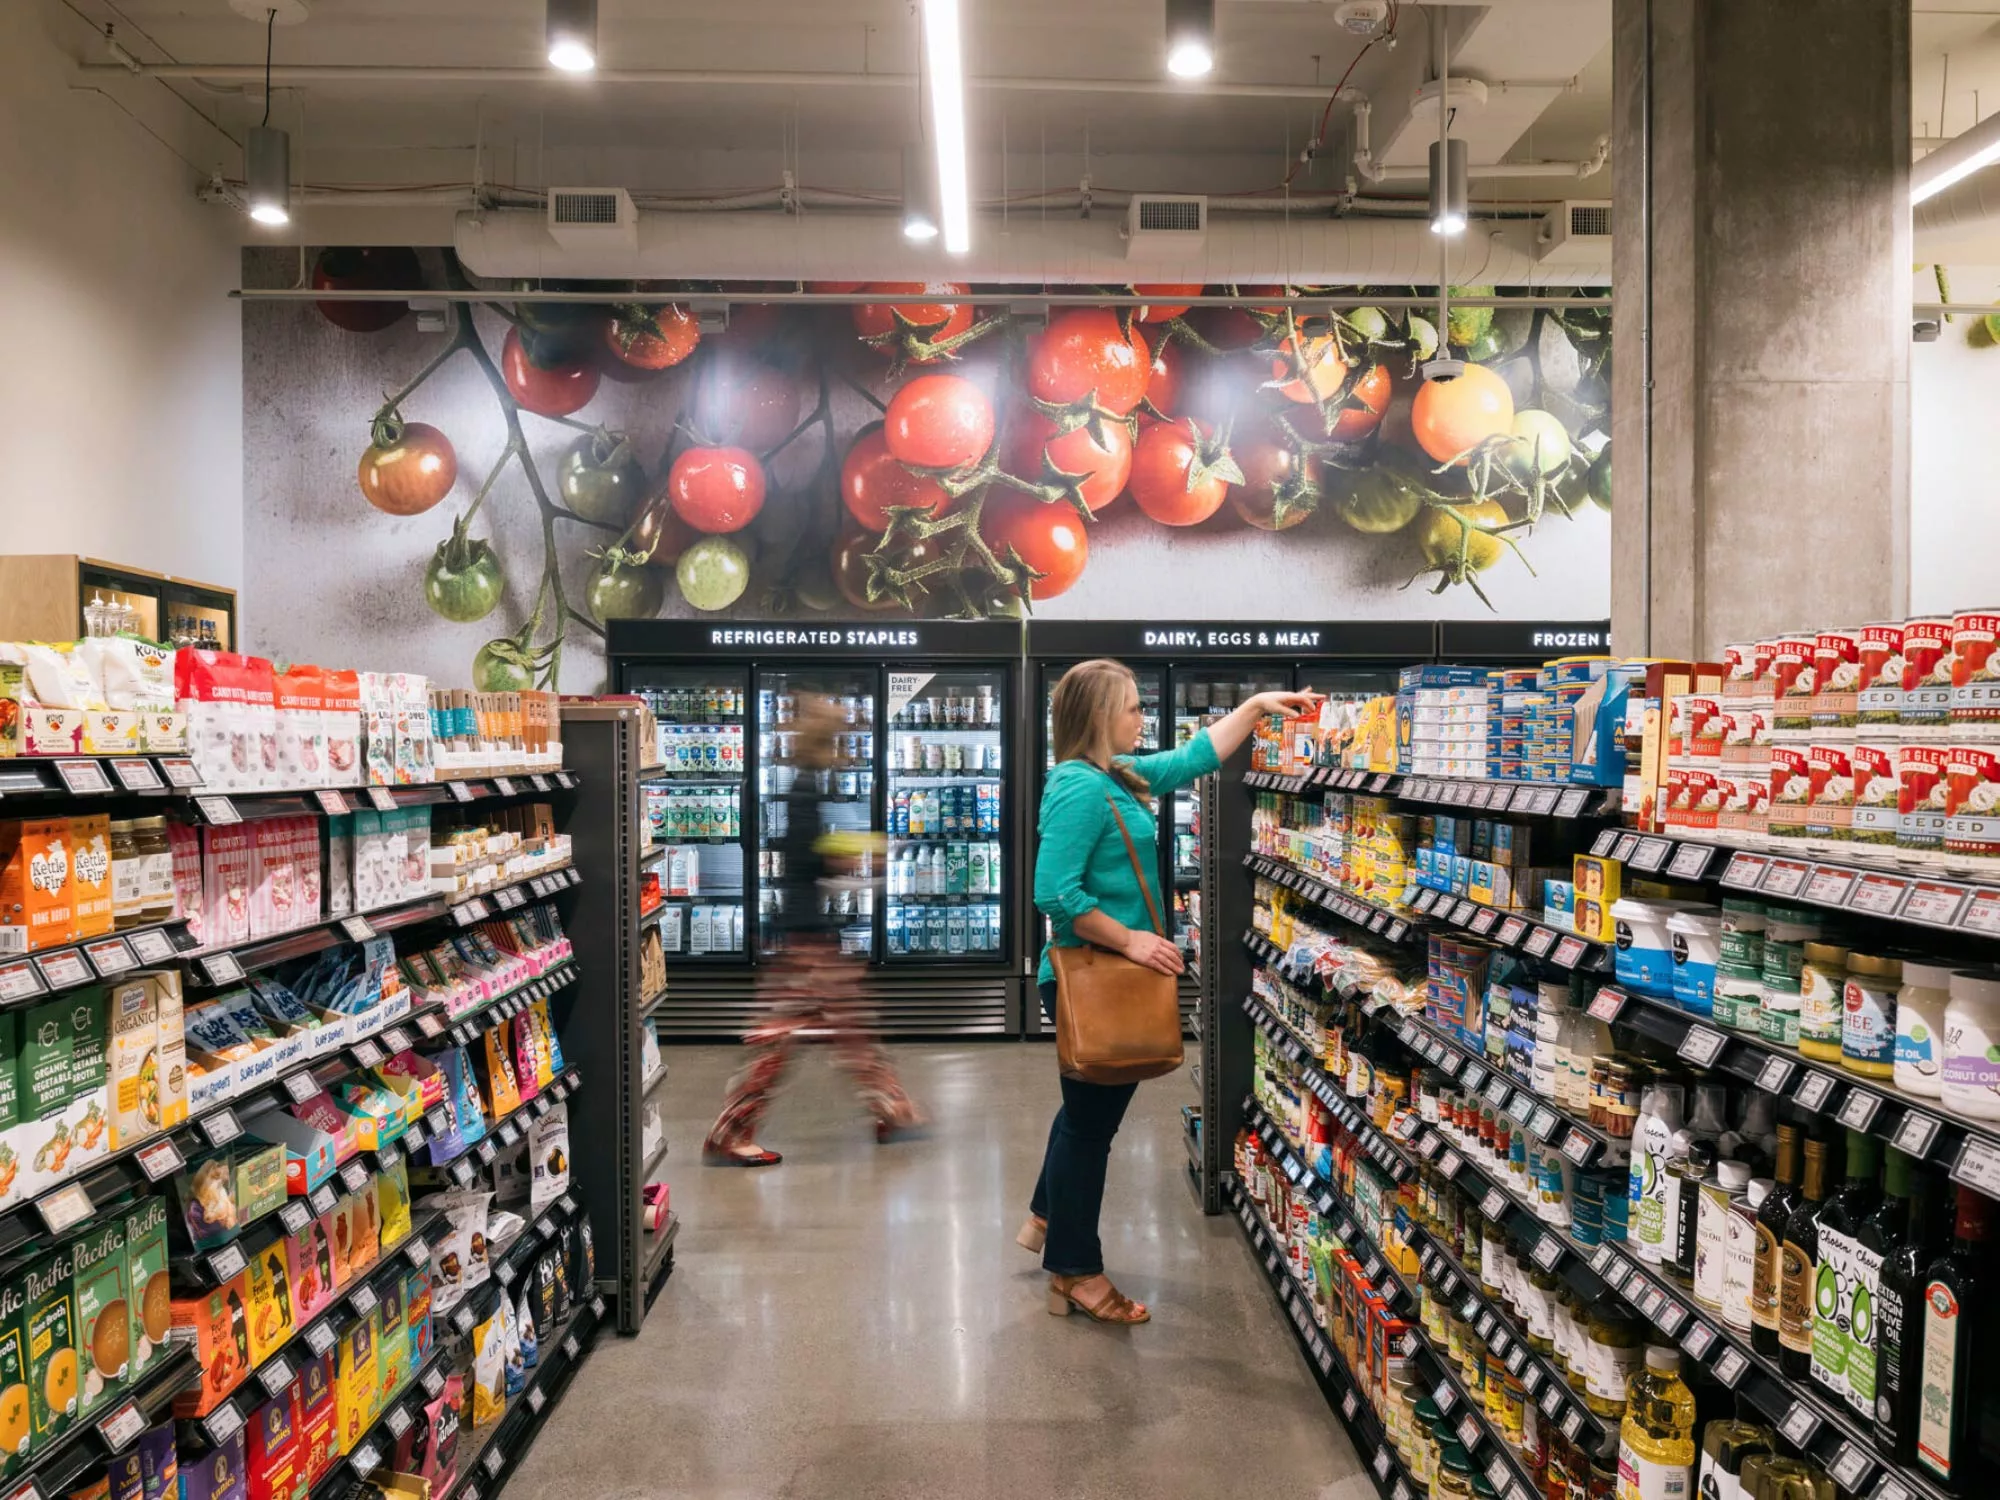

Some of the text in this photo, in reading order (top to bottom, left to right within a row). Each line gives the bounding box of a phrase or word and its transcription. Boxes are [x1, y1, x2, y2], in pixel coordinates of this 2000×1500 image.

[711, 630, 918, 645] REFRIGERATED STAPLES
[1144, 631, 1321, 648] DAIRY, EGGS & MEAT
[1533, 632, 1600, 647] FROZEN
[1868, 629, 1899, 644] GLEN
[1918, 626, 1952, 641] GLEN
[1784, 643, 1811, 657] GLEN
[1821, 637, 1848, 651] GLEN
[891, 676, 921, 684] DAIRY-
[891, 684, 913, 692] FREE
[1773, 751, 1798, 765] GLEN
[1813, 749, 1840, 765] GLEN
[1856, 748, 1880, 765] GLEN
[1914, 750, 1948, 767] GLEN
[1955, 750, 1988, 768] GLEN
[31, 859, 66, 876] Kettle
[75, 851, 107, 870] Kettle
[33, 875, 66, 891] & Fire
[76, 868, 107, 883] & Fire
[114, 1011, 157, 1034] ORGANIC
[356, 1018, 368, 1033] SURF
[314, 1033, 327, 1048] SURF
[1905, 1051, 1921, 1059] OIL
[34, 1060, 69, 1080] ORGANIC
[239, 1067, 255, 1081] SURF
[1979, 1072, 1999, 1082] OIL
[32, 1071, 72, 1093] VEGETABLE
[40, 1087, 65, 1103] BROTH
[126, 1204, 168, 1243] Pacific
[1819, 1229, 1852, 1254] Chosen
[72, 1229, 124, 1273] Pacific
[23, 1257, 74, 1305] Pacific
[252, 1280, 268, 1296] Fruit
[1879, 1283, 1903, 1306] EXTRA
[45, 1305, 67, 1326] Broth
[1879, 1309, 1903, 1331] OLIVE
[211, 1318, 226, 1333] Fruit
[1885, 1328, 1902, 1343] OIL
[306, 1386, 328, 1410] Annie's
[434, 1411, 459, 1446] Panda
[266, 1425, 291, 1451] Annie's
